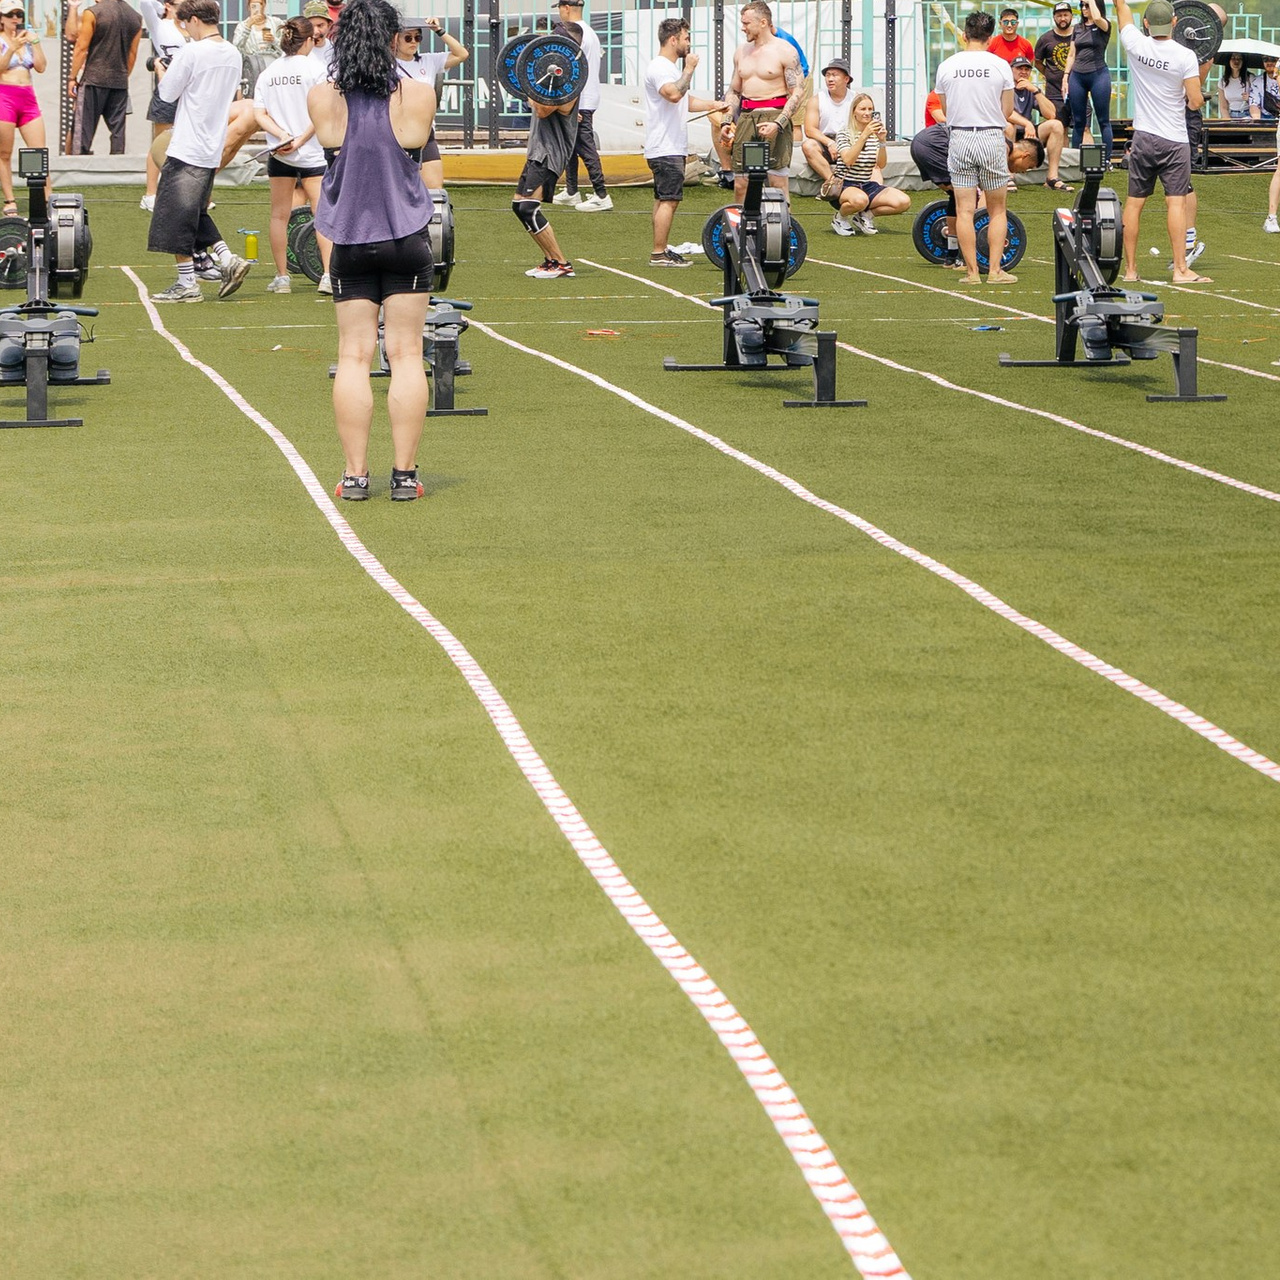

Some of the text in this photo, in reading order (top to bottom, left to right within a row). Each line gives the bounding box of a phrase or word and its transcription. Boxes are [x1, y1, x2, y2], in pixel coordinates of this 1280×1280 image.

[543, 44, 580, 82] YOUSTEEL
[1137, 55, 1170, 71] JUDGE
[269, 75, 302, 87] JUDGE
[953, 69, 990, 79] JUDGE
[922, 209, 947, 251] YOUSTEEL
